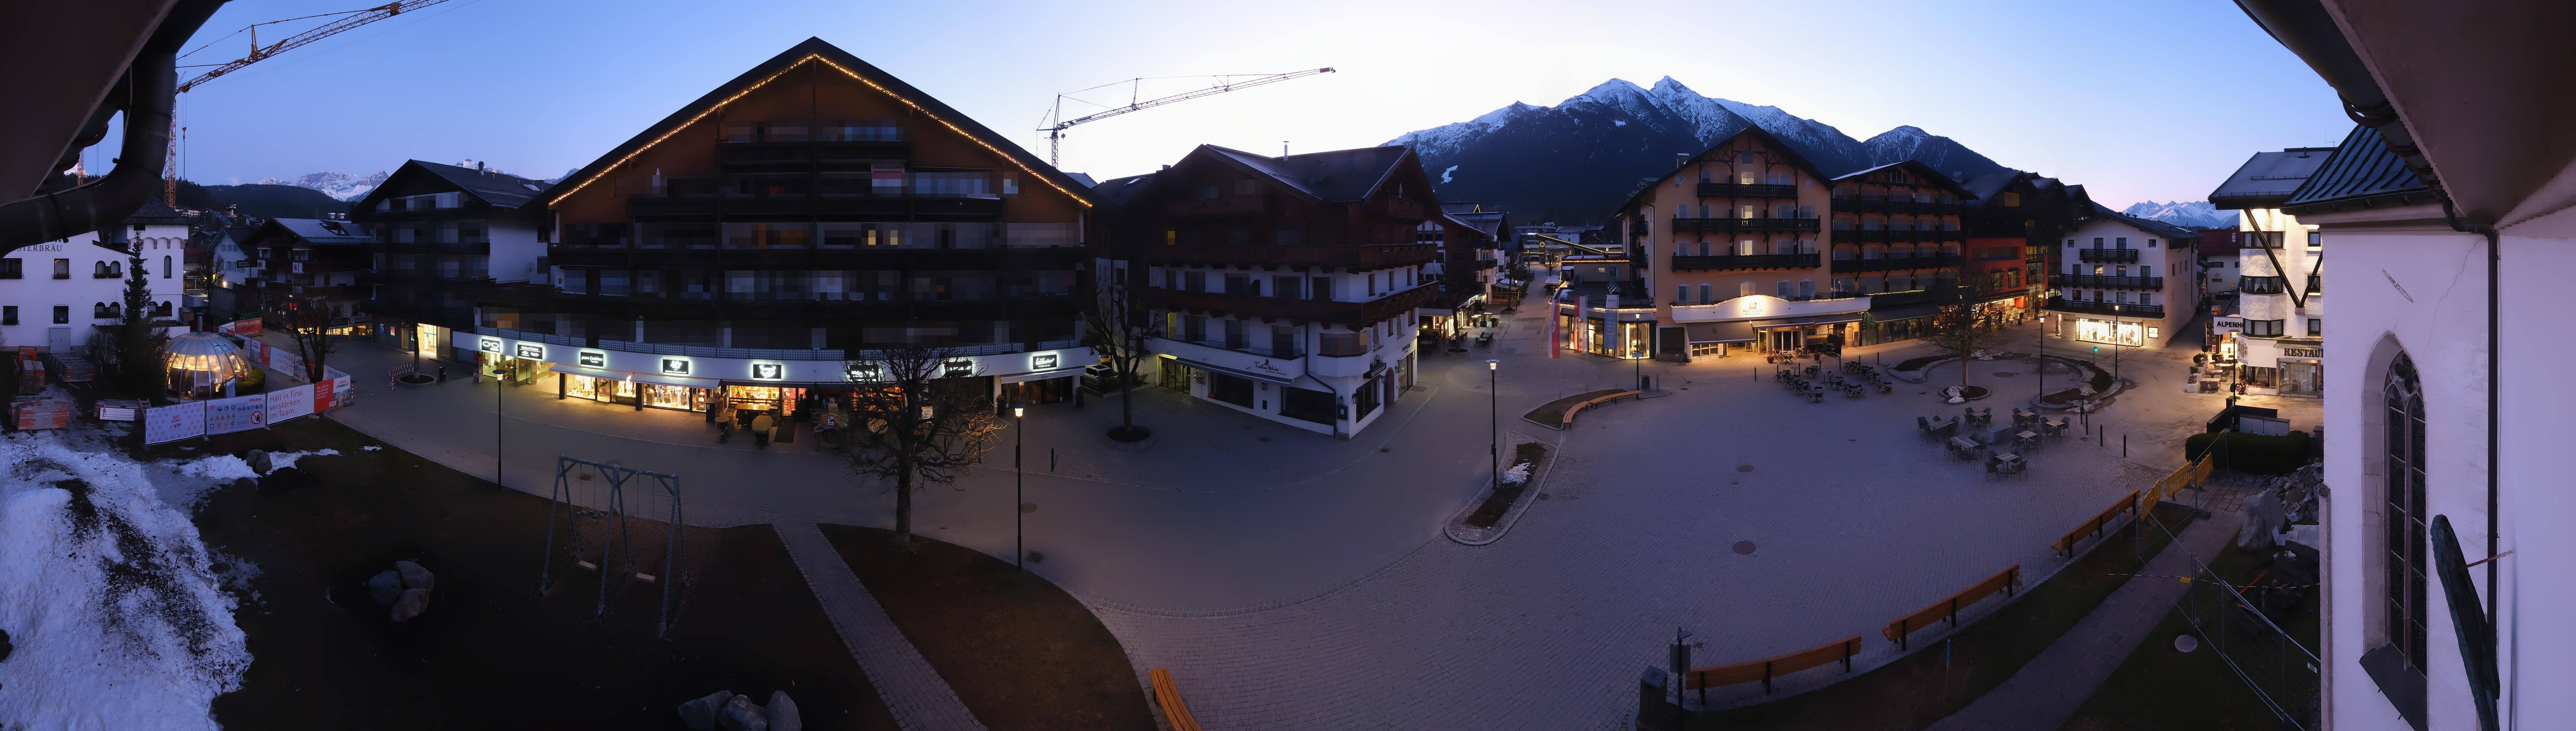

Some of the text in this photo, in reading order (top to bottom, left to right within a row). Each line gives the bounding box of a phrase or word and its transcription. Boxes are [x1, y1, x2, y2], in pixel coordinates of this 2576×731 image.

[1402, 343, 1410, 352] SAILER
[1371, 364, 1386, 377] RESTAURANT
[270, 394, 281, 402] Hall
[269, 399, 302, 411] verstärken.
